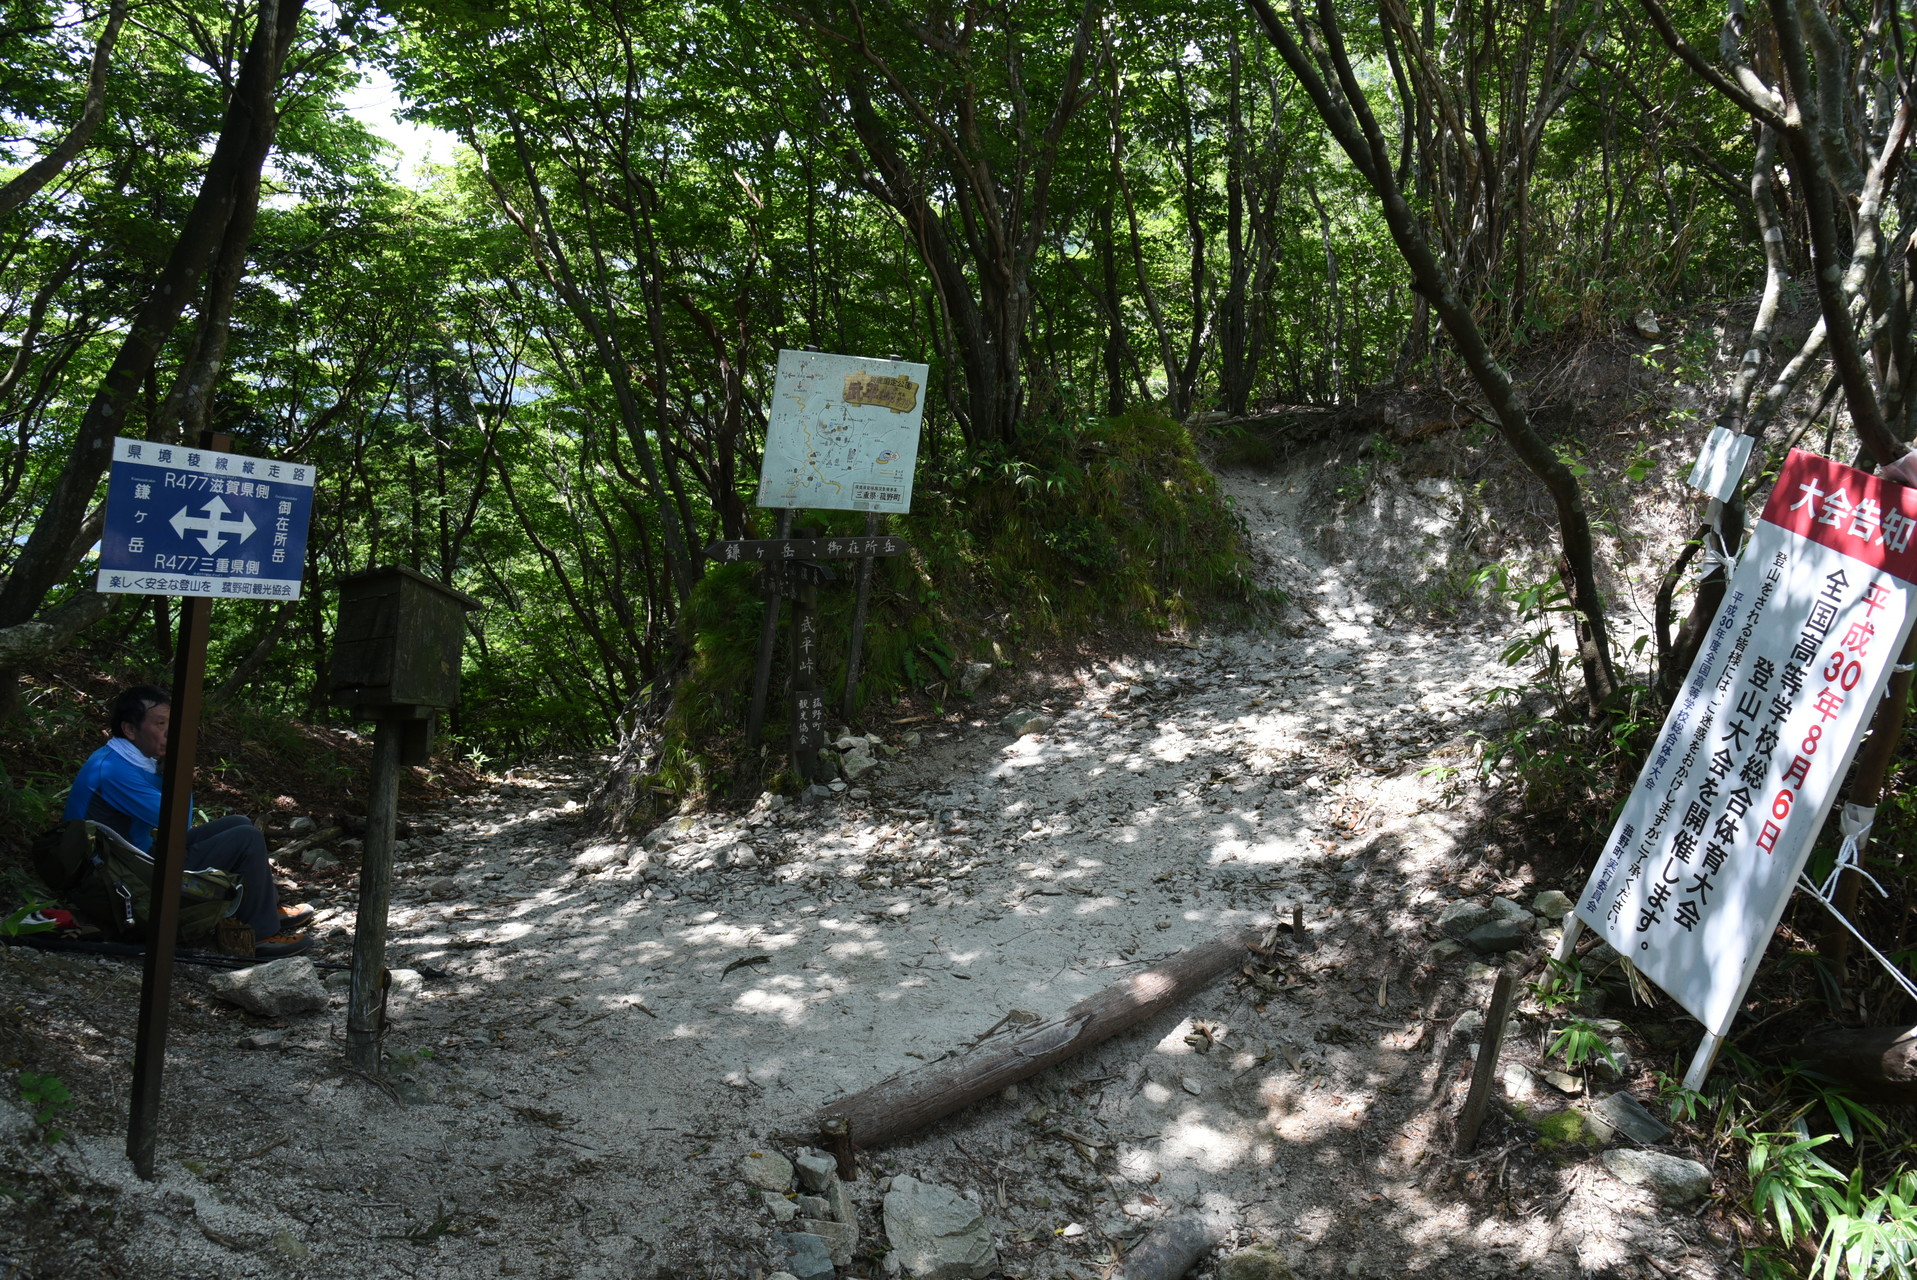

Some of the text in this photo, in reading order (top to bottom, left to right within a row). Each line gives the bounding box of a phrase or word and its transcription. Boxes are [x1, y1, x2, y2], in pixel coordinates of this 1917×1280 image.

[127, 444, 305, 481] 県境稜線縦走路
[164, 472, 269, 499] R477滋賀県側
[272, 501, 291, 563] 御在所岳
[1790, 477, 1916, 555] 大会告知
[155, 554, 260, 574] R477三重県側
[828, 540, 896, 556] 御在所岳
[109, 576, 291, 596] 楽しく安全な登山を 菰野町観光協会
[799, 616, 816, 676] 武平峠
[812, 699, 822, 731] 菰野町
[1644, 591, 1744, 791] 平成30年度全国高等学校総合体育大会
[1755, 582, 1892, 855] 平成30年8月6日
[798, 699, 809, 745] 観光協会
[1606, 552, 1784, 934] 登山をされる皆様には、ご迷惑をおかけしますがご了承ください。
[1672, 569, 1850, 934] 全国高等学校総合体育大会
[1635, 656, 1776, 954] 登山大会を開催します。
